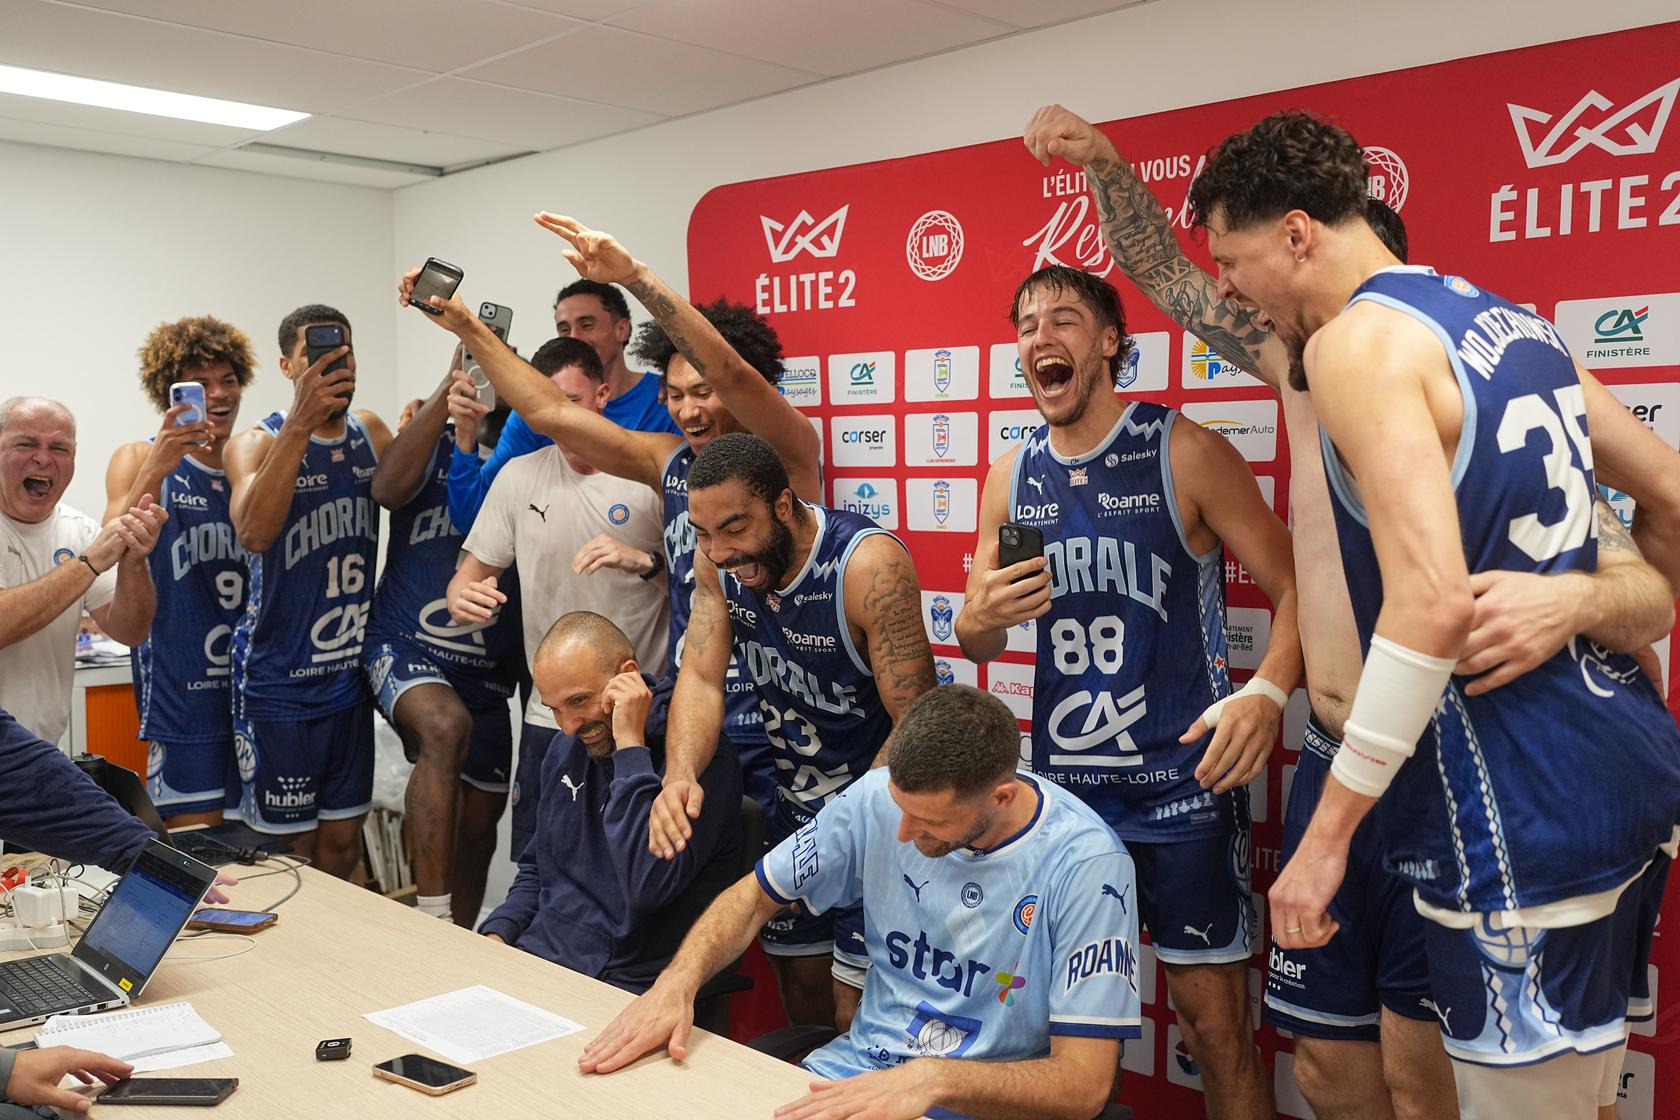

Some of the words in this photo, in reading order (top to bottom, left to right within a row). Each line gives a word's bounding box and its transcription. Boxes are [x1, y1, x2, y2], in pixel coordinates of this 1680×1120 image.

[1042, 169, 1090, 198] L'ÉLIT
[1139, 154, 1191, 183] VOUS
[922, 234, 949, 258] LNB
[1586, 347, 1650, 358] FINISTÈRE
[842, 430, 887, 443] corser
[1000, 426, 1037, 440] cors
[1120, 449, 1157, 463] Salesky
[295, 473, 328, 488] oire
[171, 491, 208, 507] Loire
[843, 499, 890, 519] inizys
[1098, 492, 1160, 510] Roanne
[1017, 503, 1059, 520] Loire
[1097, 509, 1131, 518] L'ESPRIT
[1135, 506, 1160, 514] SPORT
[285, 496, 378, 571] CHORAL
[171, 522, 250, 581] CHORA
[326, 552, 365, 598] 16
[1043, 536, 1172, 623] ORALE
[215, 570, 243, 610] 9
[727, 599, 757, 624] oire
[782, 626, 836, 647] Roanne
[1050, 615, 1125, 675] 88
[1228, 632, 1253, 643] istère
[289, 666, 325, 678] LOIRE
[739, 641, 866, 719] ORALE
[187, 681, 219, 690] LOIRE
[760, 699, 822, 757] 23
[1070, 768, 1180, 785] HAUTE-LOIRE
[265, 790, 316, 807] hubler
[885, 930, 991, 998] star
[1065, 937, 1138, 996] ROANNE
